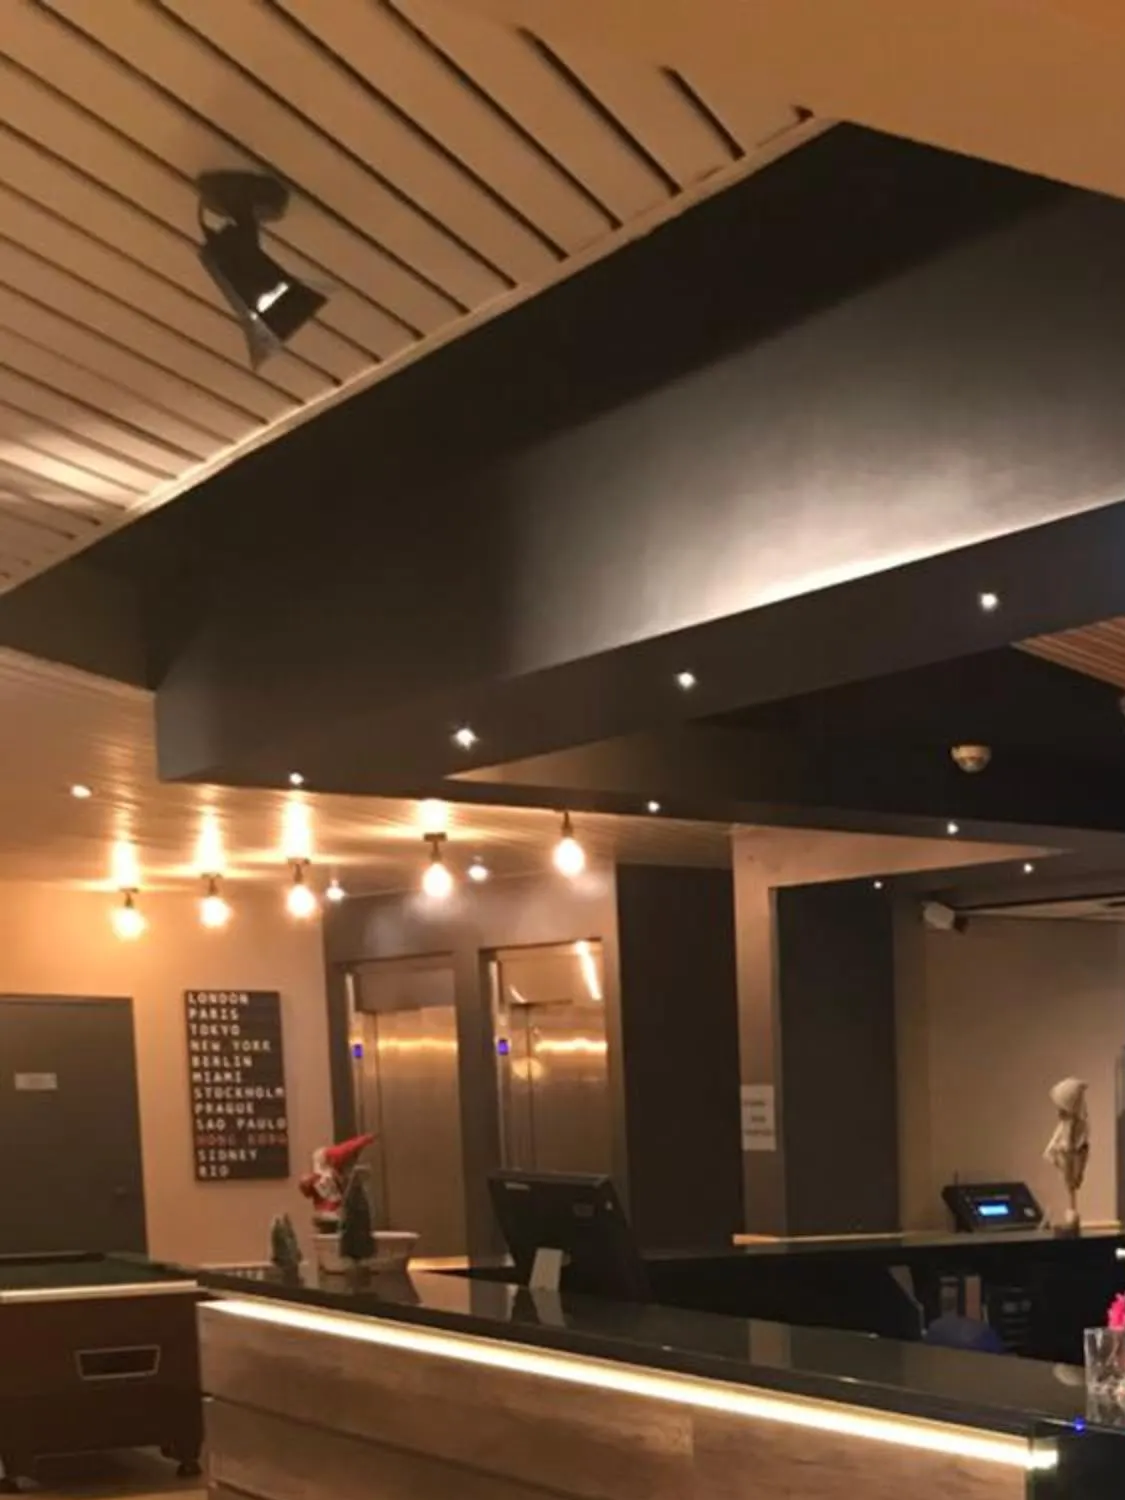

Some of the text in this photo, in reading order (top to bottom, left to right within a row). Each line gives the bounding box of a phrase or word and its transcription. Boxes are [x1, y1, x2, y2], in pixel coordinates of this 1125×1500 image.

[188, 992, 249, 1006] LONDON
[189, 1007, 239, 1021] PARIS
[190, 1023, 240, 1036] TOKYO
[190, 1040, 271, 1052] NEW YORK
[191, 1055, 253, 1068] BERLIN
[192, 1071, 242, 1084] MIAMI
[194, 1086, 284, 1099] STOCKHOLM
[195, 1102, 255, 1115] PRAGUE
[236, 1117, 287, 1130] PAULO
[198, 1148, 258, 1162] SIDNEY
[199, 1164, 230, 1177] RIO
